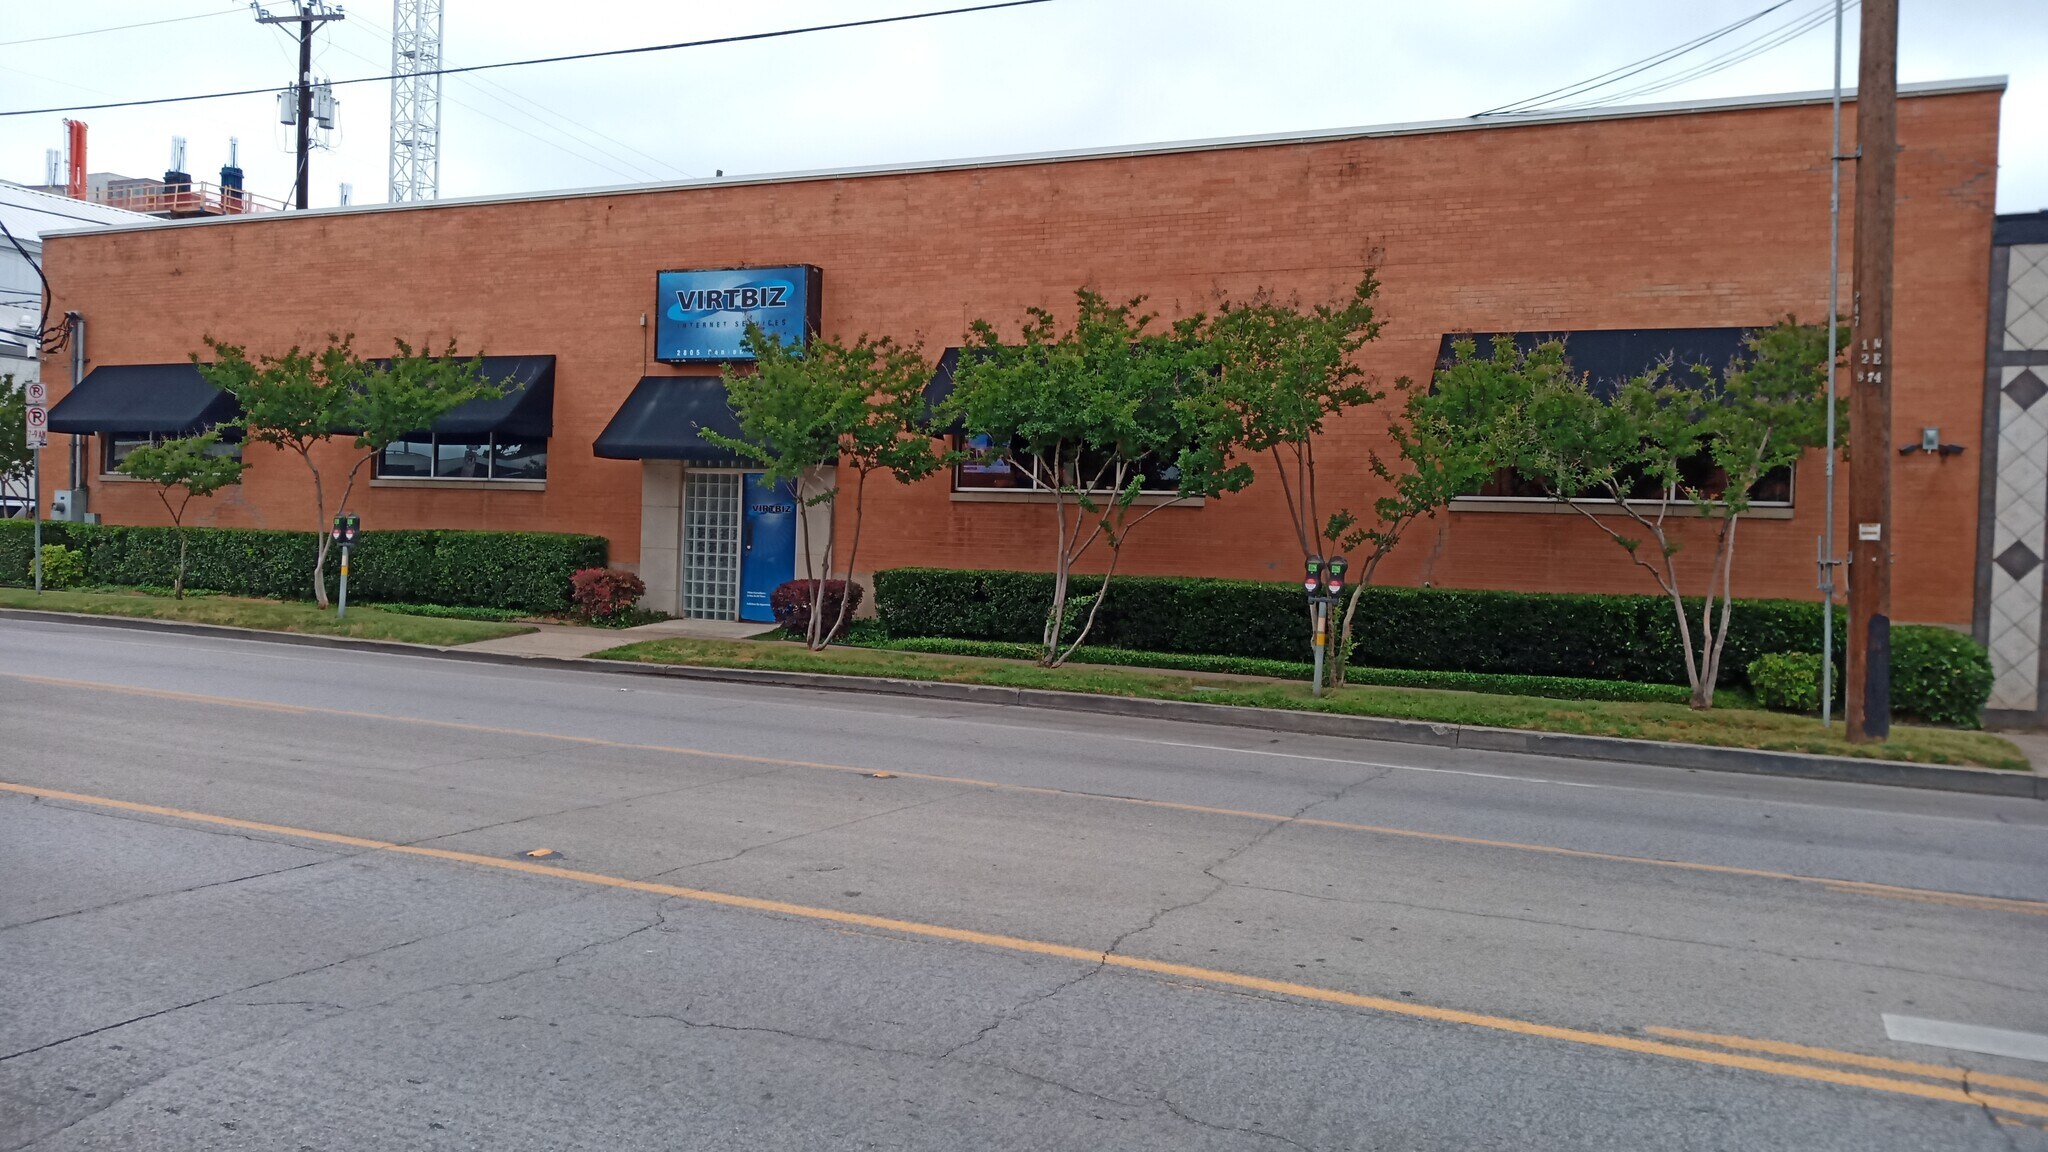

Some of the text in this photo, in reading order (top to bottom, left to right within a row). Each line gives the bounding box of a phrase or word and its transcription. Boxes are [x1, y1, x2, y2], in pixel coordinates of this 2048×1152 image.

[676, 286, 787, 311] VIRTBIZ
[677, 319, 786, 329] INTERNET SEVICES
[1861, 353, 1882, 365] 2 E
[752, 504, 791, 513] VIRTBIZ
